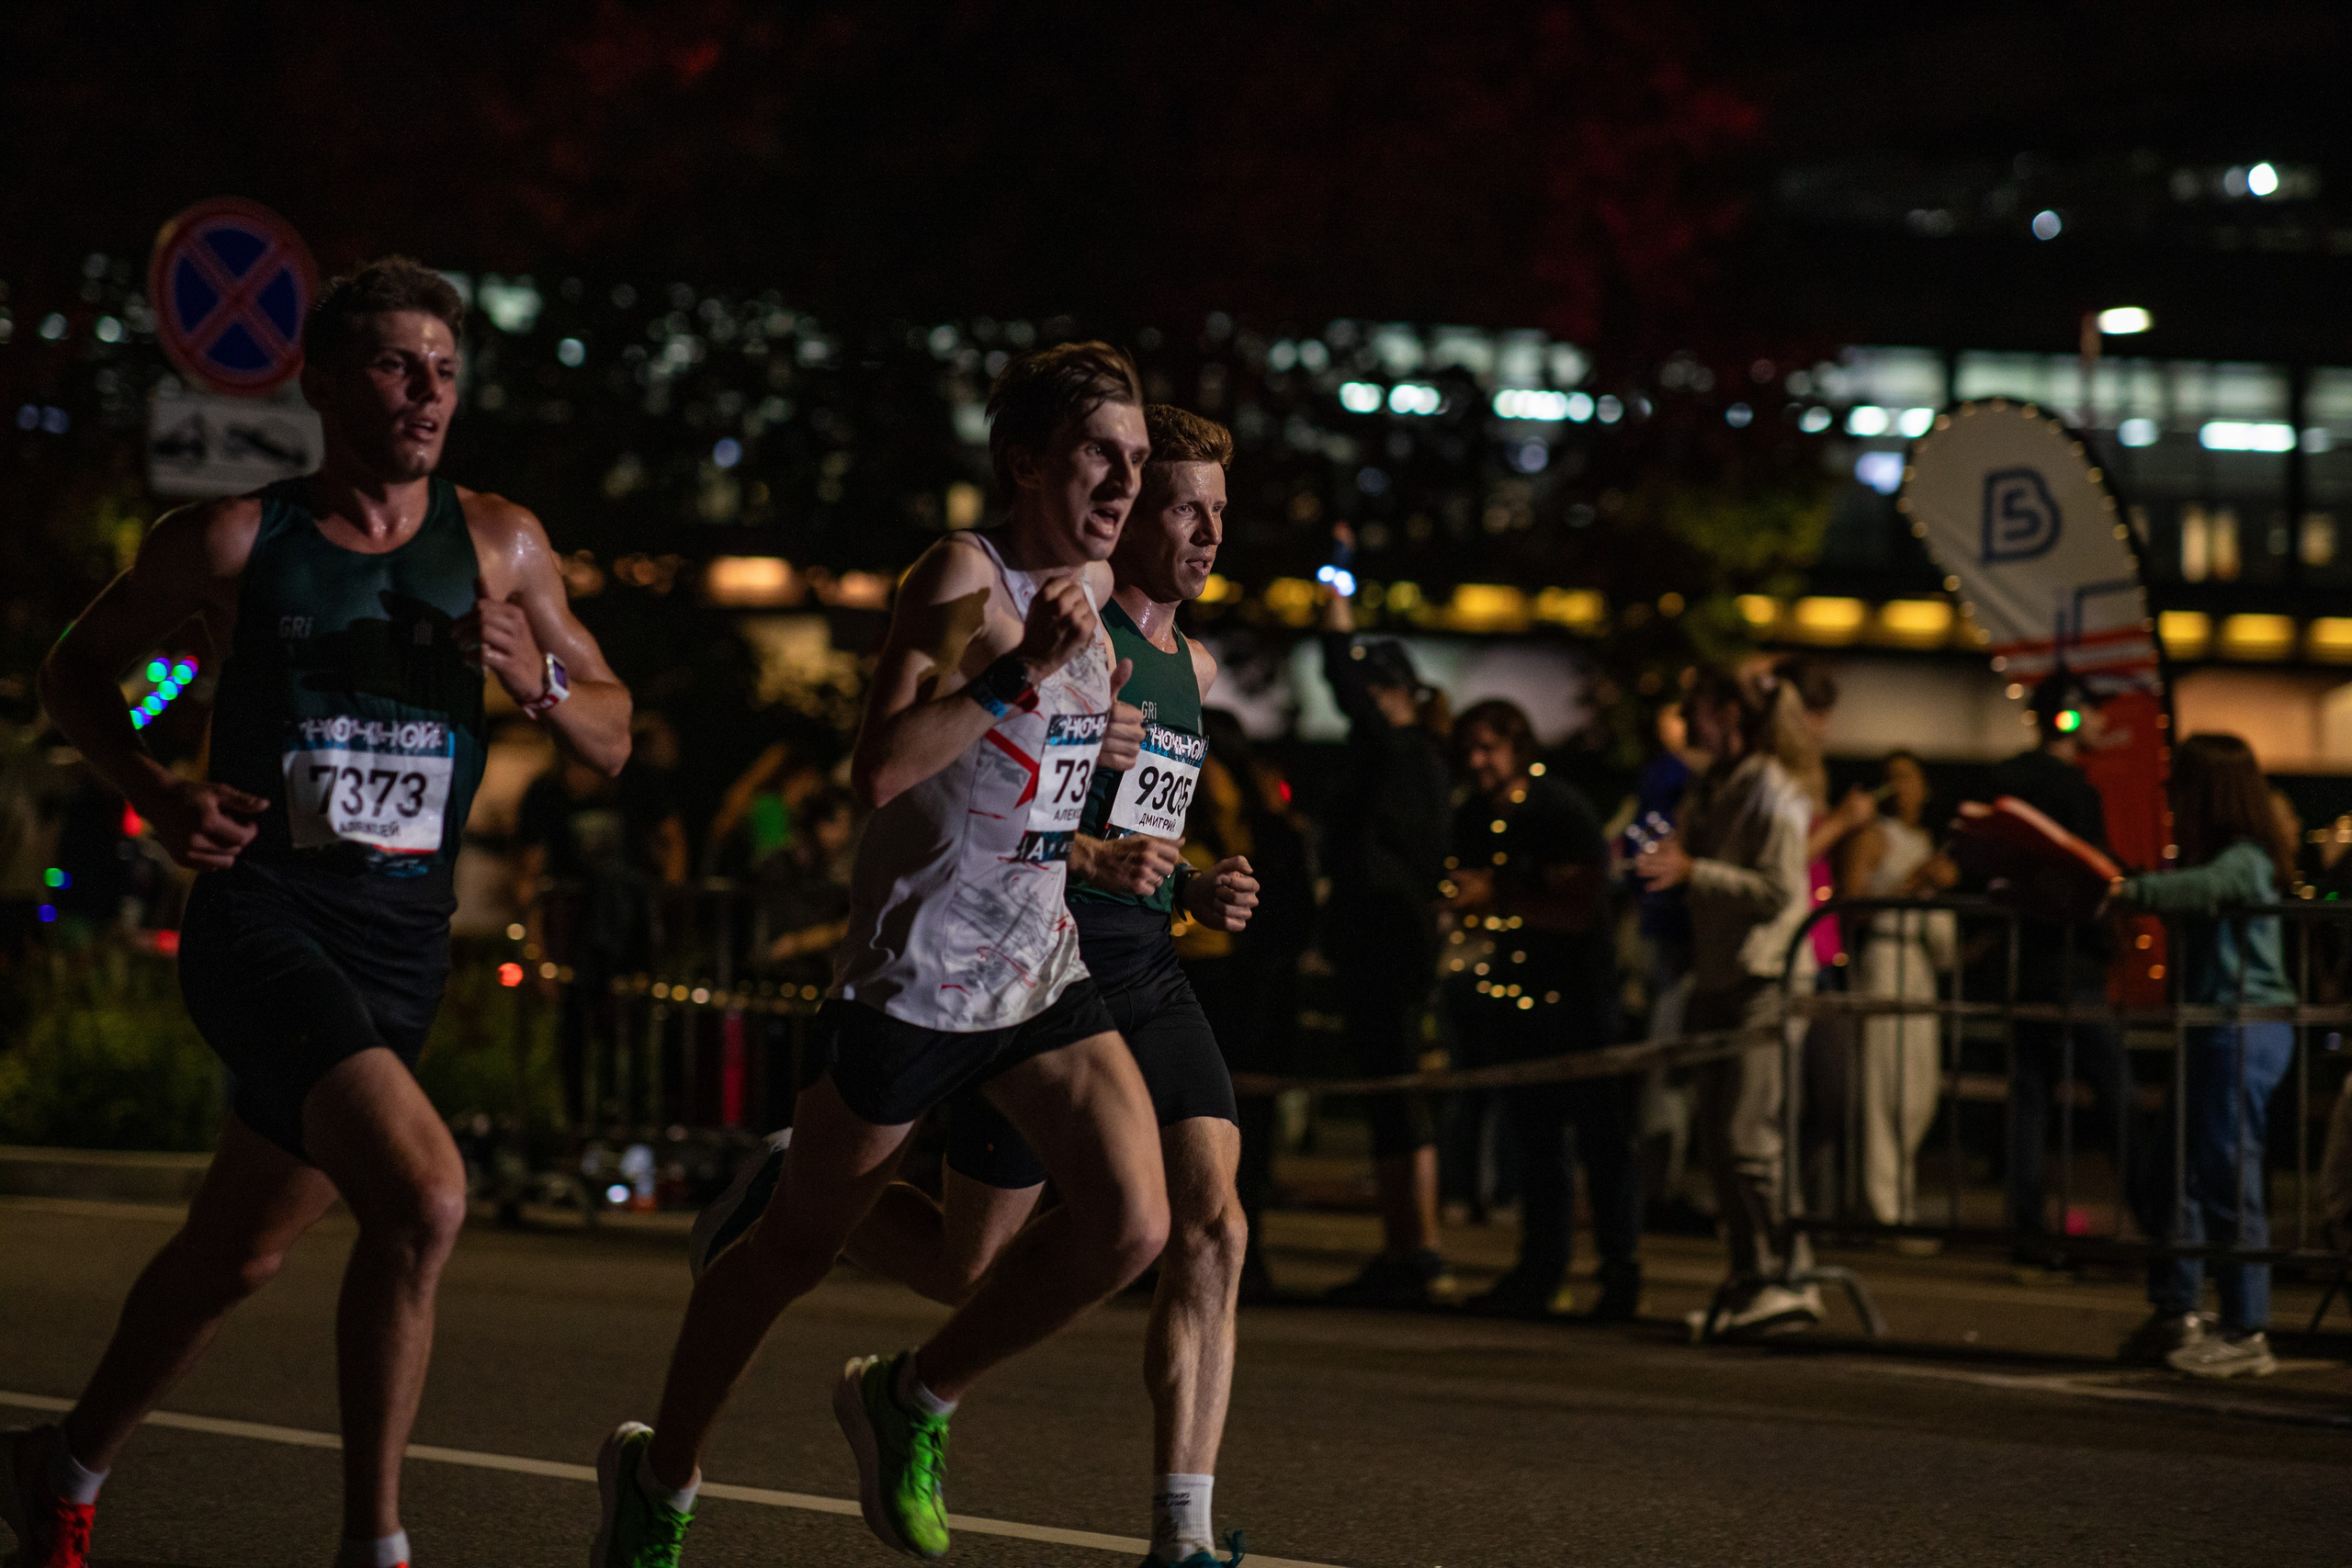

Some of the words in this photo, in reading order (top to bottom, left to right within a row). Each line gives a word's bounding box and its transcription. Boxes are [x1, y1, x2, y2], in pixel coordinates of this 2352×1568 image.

[1141, 700, 1158, 720] GRi
[310, 765, 426, 818] 7373
[1053, 760, 1092, 804] 73
[1135, 766, 1193, 817] 9305
[1138, 813, 1177, 832] ДМИТРИЙ
